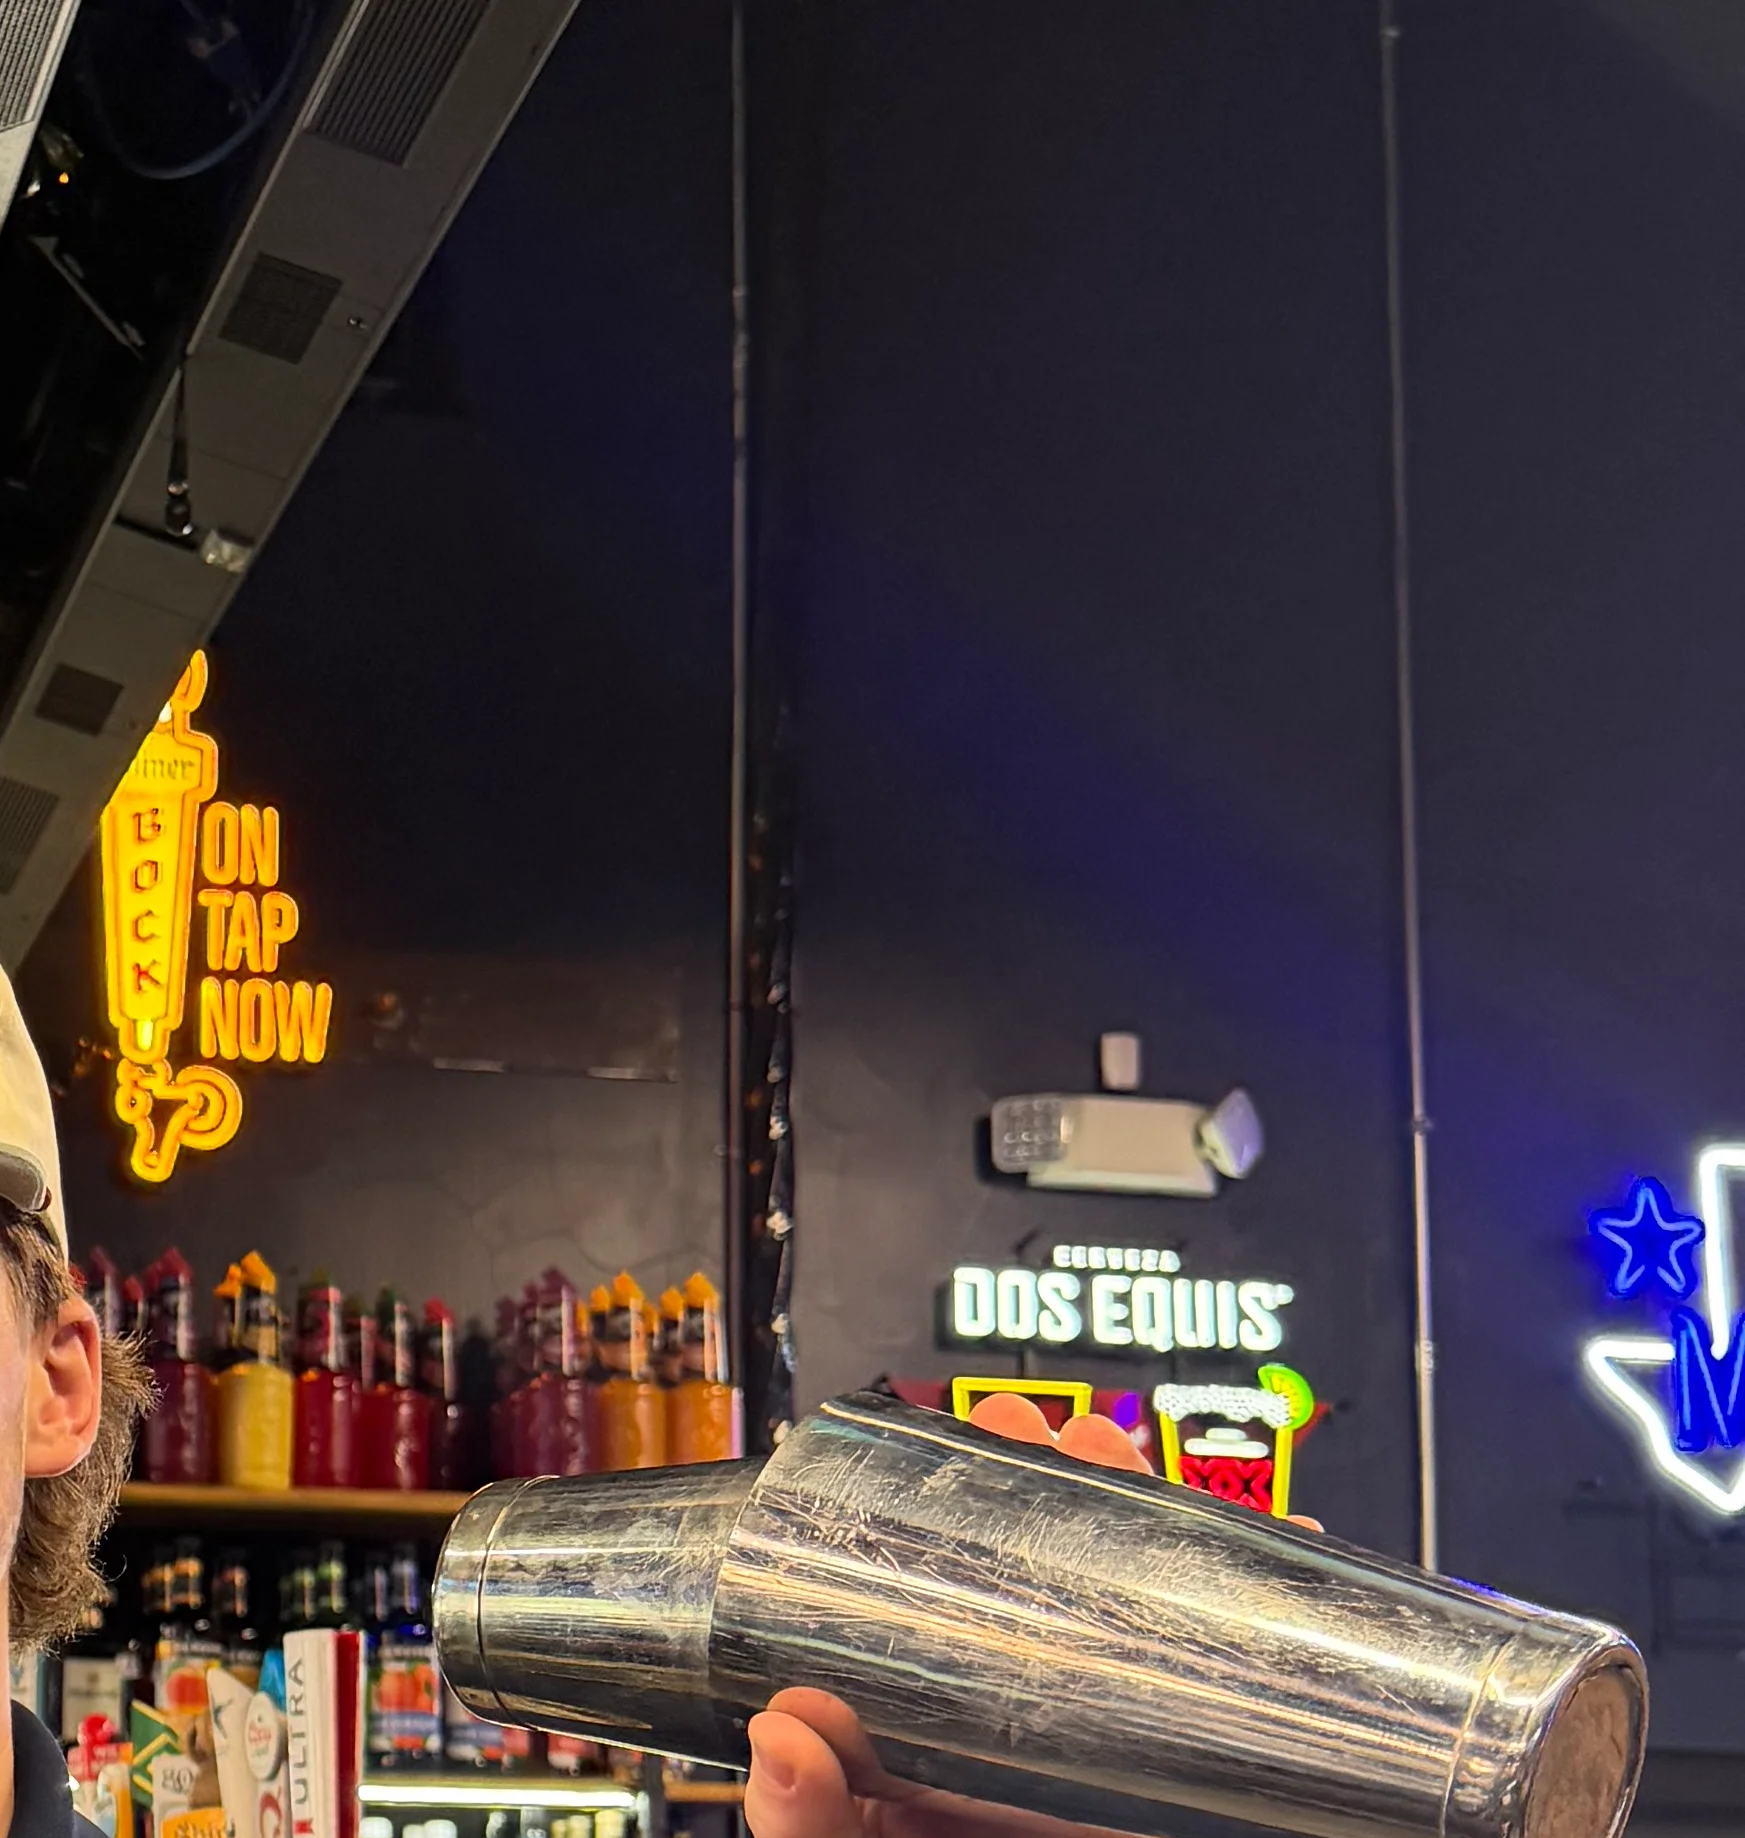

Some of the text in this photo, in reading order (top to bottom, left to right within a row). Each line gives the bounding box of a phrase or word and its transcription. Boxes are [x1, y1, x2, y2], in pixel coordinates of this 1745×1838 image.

[202, 801, 280, 886] ON
[132, 807, 164, 990] BOCK
[198, 889, 300, 973] TAP
[200, 976, 333, 1063] NOW
[953, 1266, 1294, 1352] DOS EQUIS
[287, 1657, 309, 1805] ULTRA
